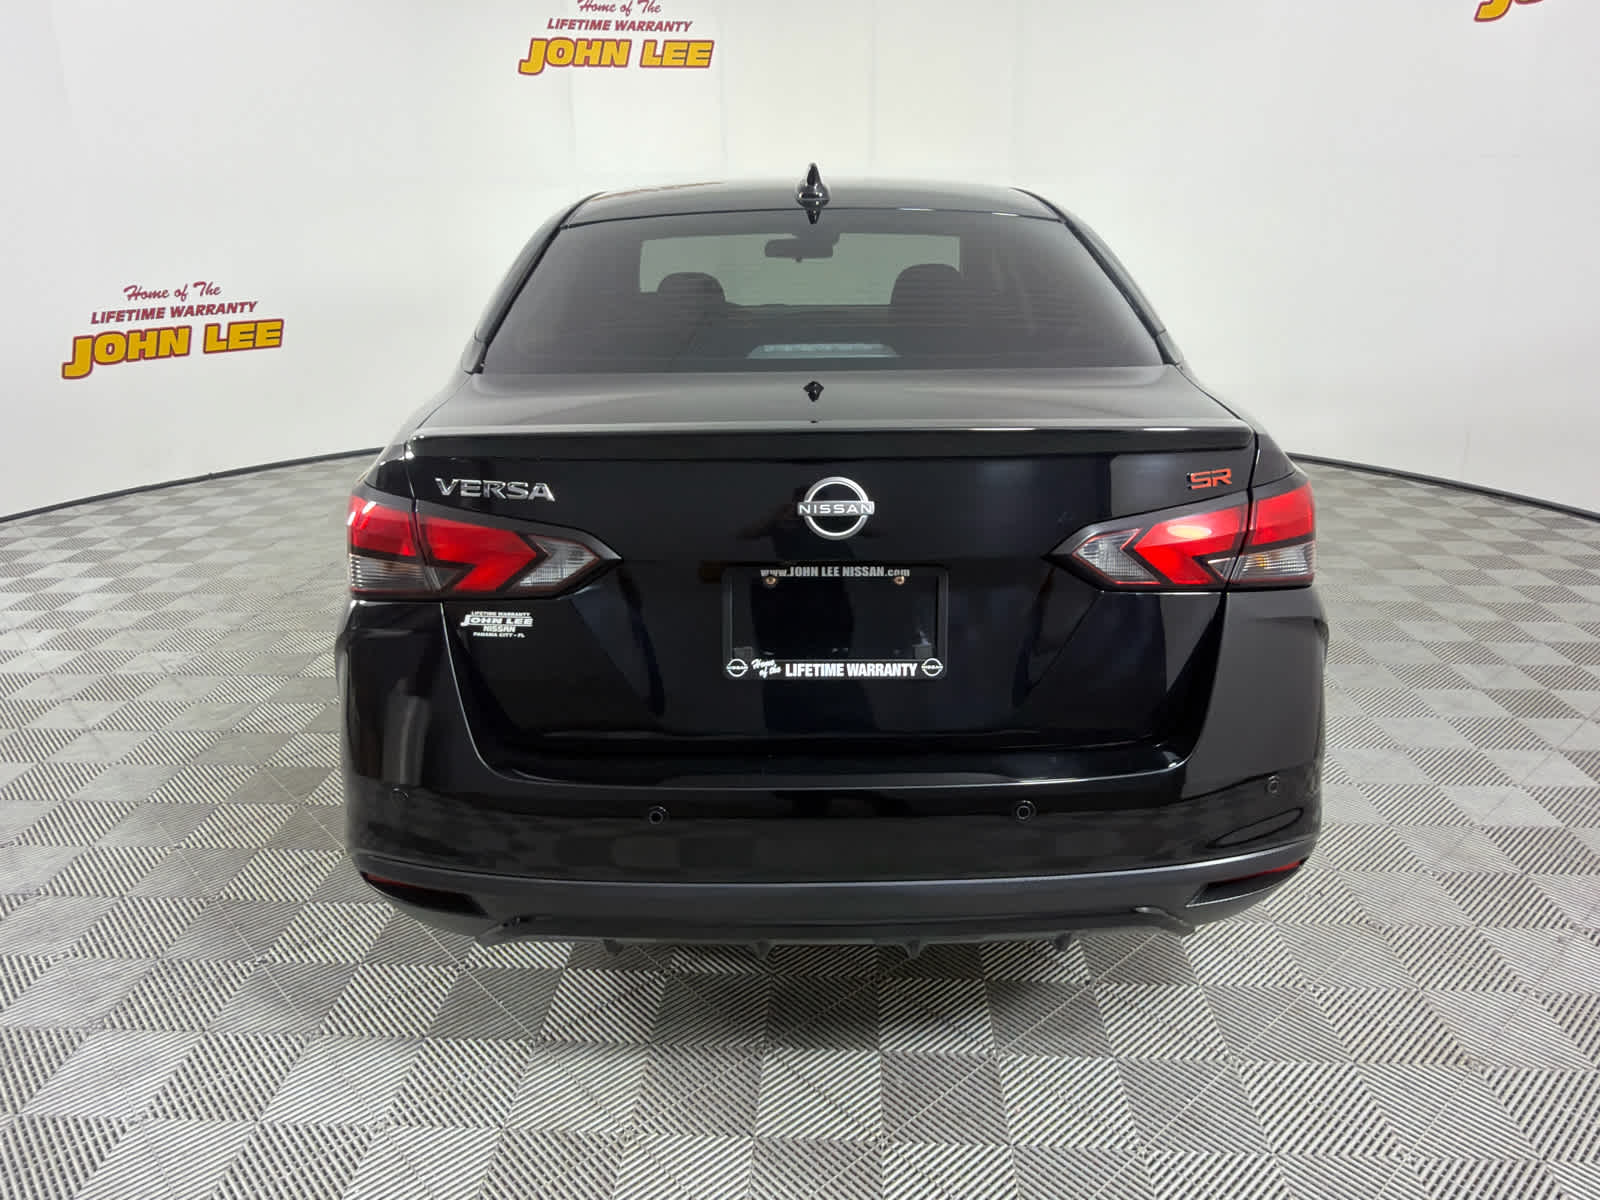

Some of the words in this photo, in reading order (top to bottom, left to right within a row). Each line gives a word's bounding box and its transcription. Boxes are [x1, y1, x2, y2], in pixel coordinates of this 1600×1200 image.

[578, 0, 617, 13] Home
[619, 2, 633, 17] of
[637, 0, 662, 13] The
[547, 18, 611, 31] LIFETIME
[614, 20, 693, 32] WARRANTY
[518, 36, 632, 76] JOHN
[639, 39, 715, 69] LEE
[123, 284, 170, 301] Home
[173, 284, 189, 302] of
[193, 281, 222, 297] The
[90, 307, 165, 325] LIFETIME
[170, 301, 258, 318] WARRANTY
[61, 325, 192, 380] JOHN
[203, 318, 284, 354] LEE
[1190, 467, 1233, 490] SR
[434, 477, 556, 502] VERSA
[799, 504, 873, 514] NISSAN
[760, 566, 819, 577] www.JOHN
[821, 566, 840, 577] LEE
[842, 566, 910, 577] NISSAN.com
[460, 614, 503, 627] JOHN
[483, 625, 516, 633] NISSAN
[751, 659, 775, 669] Home
[785, 663, 844, 677] LIFETIME
[847, 663, 918, 677] WARRANTY
